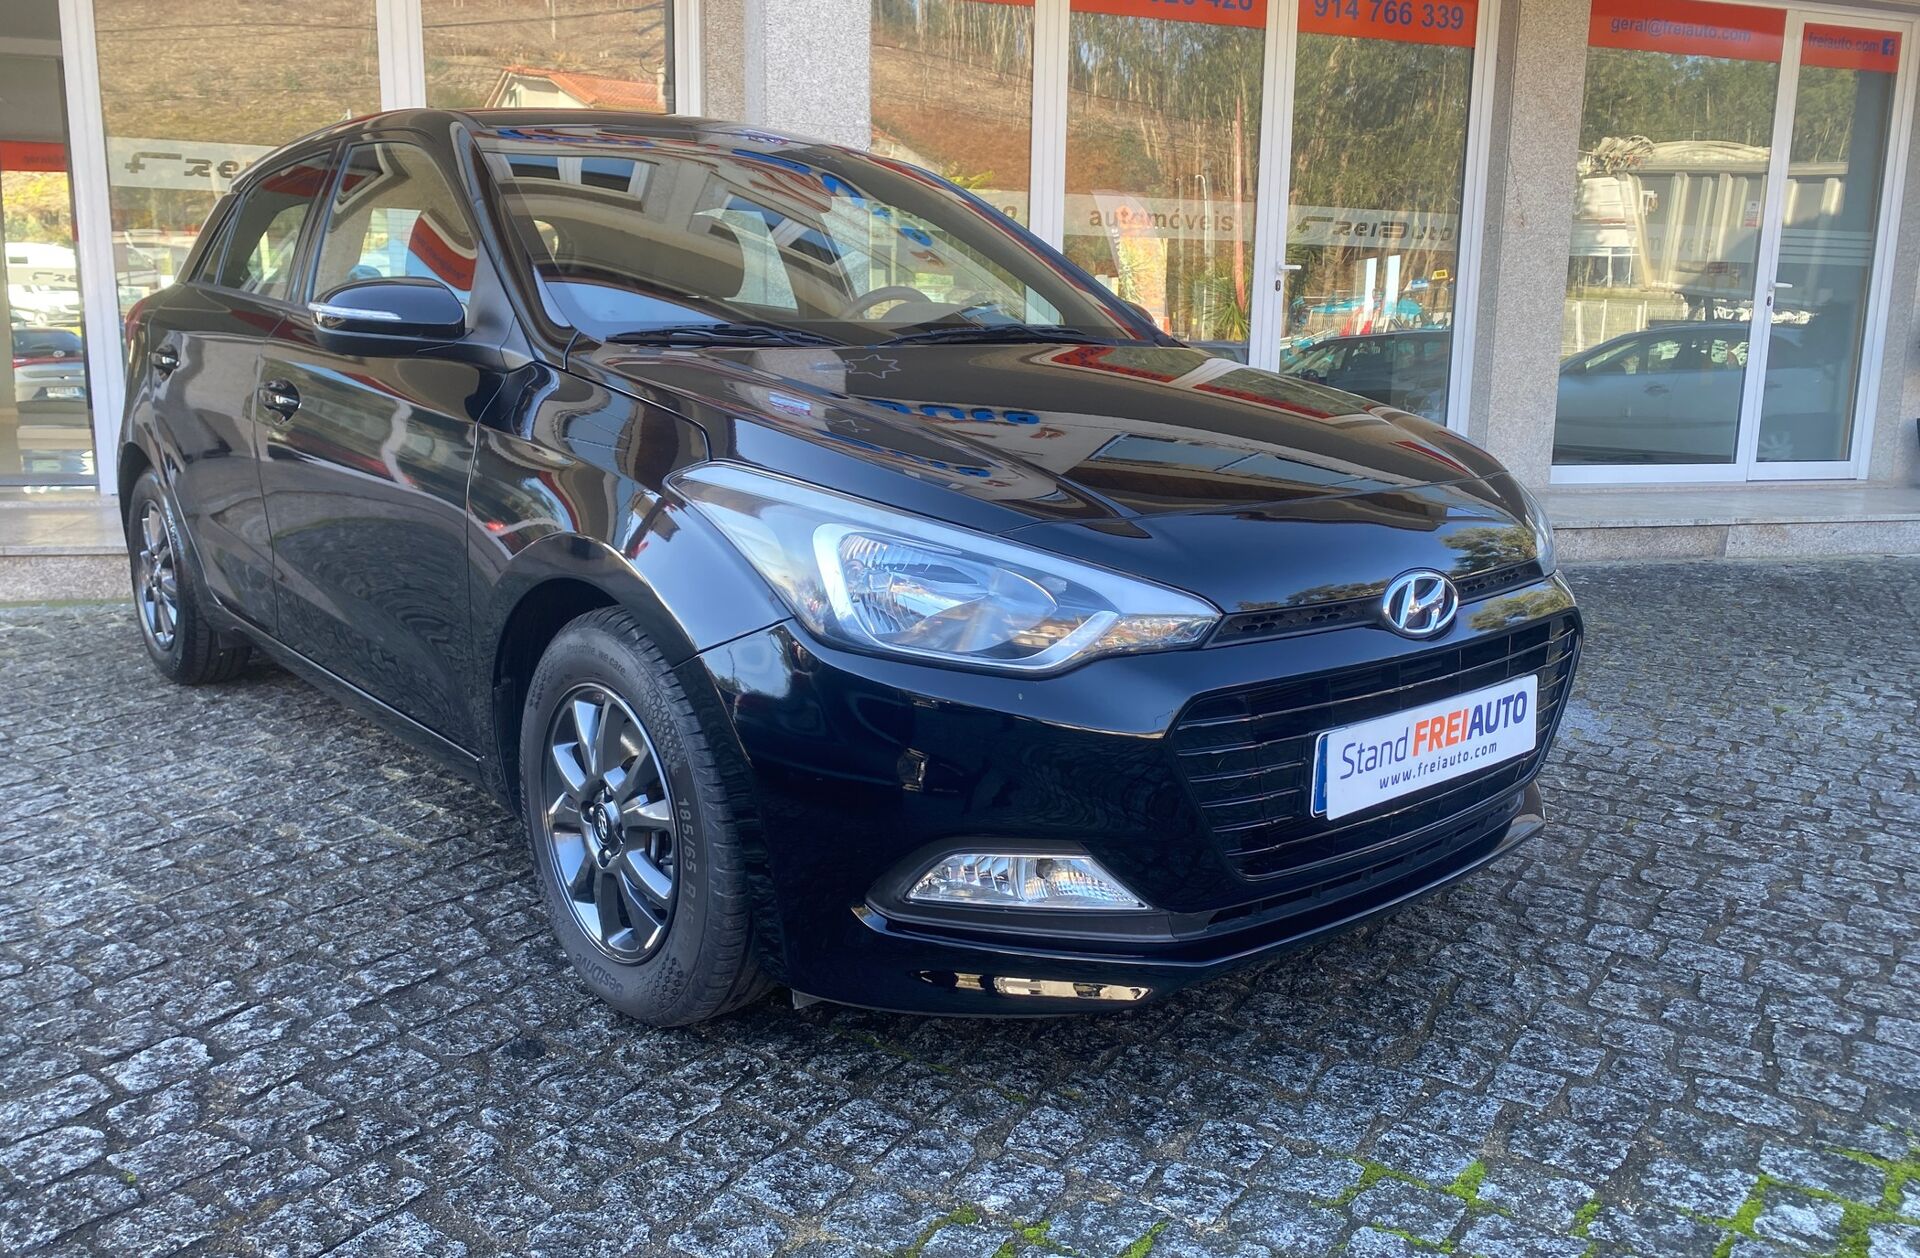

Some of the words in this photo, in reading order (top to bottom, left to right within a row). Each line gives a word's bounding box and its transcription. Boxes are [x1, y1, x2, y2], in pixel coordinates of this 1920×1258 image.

[1315, 0, 1359, 20] 914
[1370, 0, 1412, 25] 766
[1422, 4, 1465, 31] 339
[1610, 17, 1751, 42] geral@freiauto.com
[1340, 727, 1409, 779] Stand
[1413, 690, 1528, 757] FREIAUTO
[1379, 741, 1497, 789] www.freiauto.com
[678, 797, 697, 874] 185/65
[575, 953, 625, 999] BestDrive
